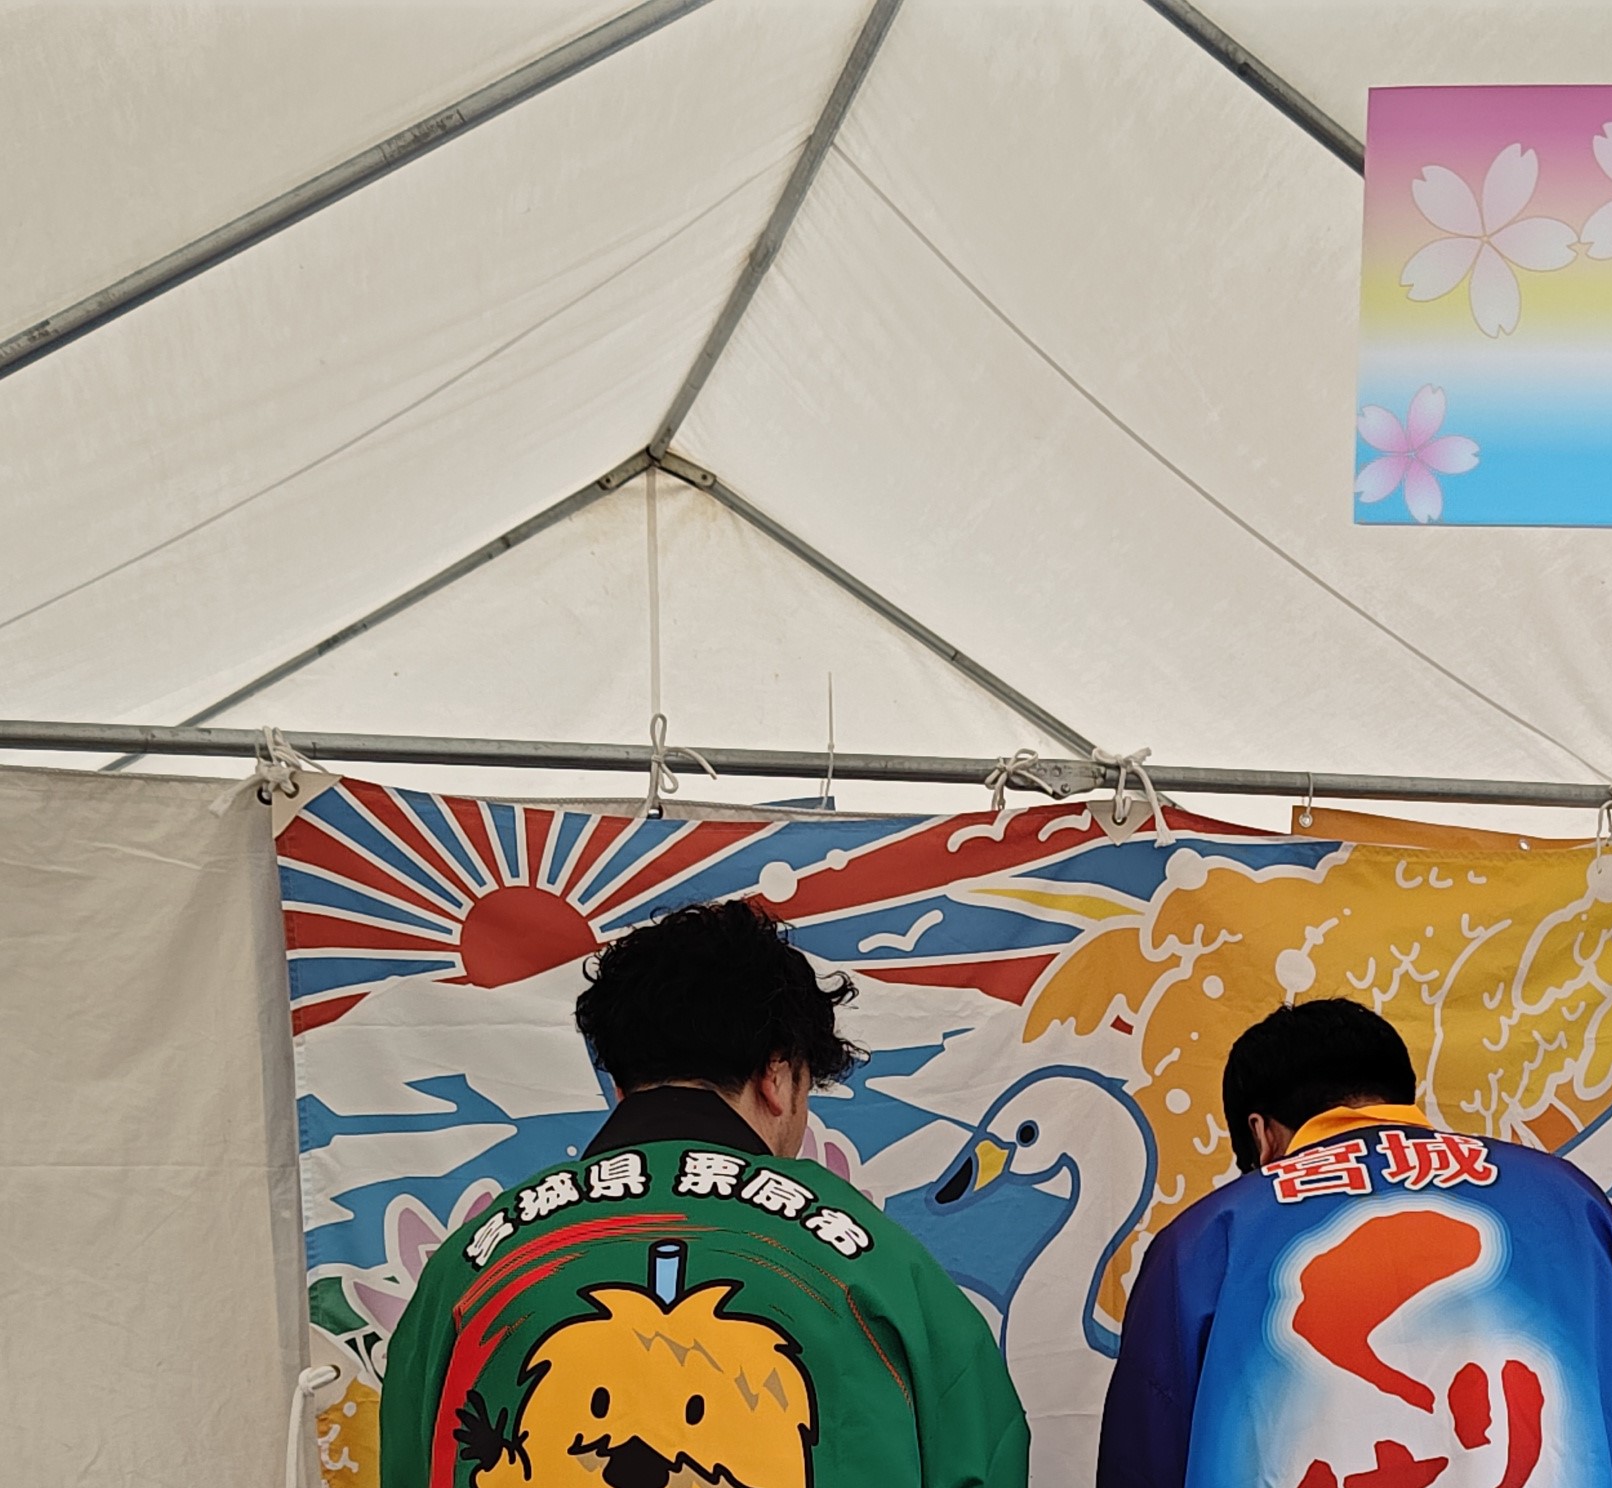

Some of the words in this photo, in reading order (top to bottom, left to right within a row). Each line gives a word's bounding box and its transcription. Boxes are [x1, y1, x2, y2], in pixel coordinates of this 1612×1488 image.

[466, 1152, 647, 1267] 宮城県
[678, 1151, 872, 1257] 栗原市
[1263, 1131, 1497, 1203] 宮城
